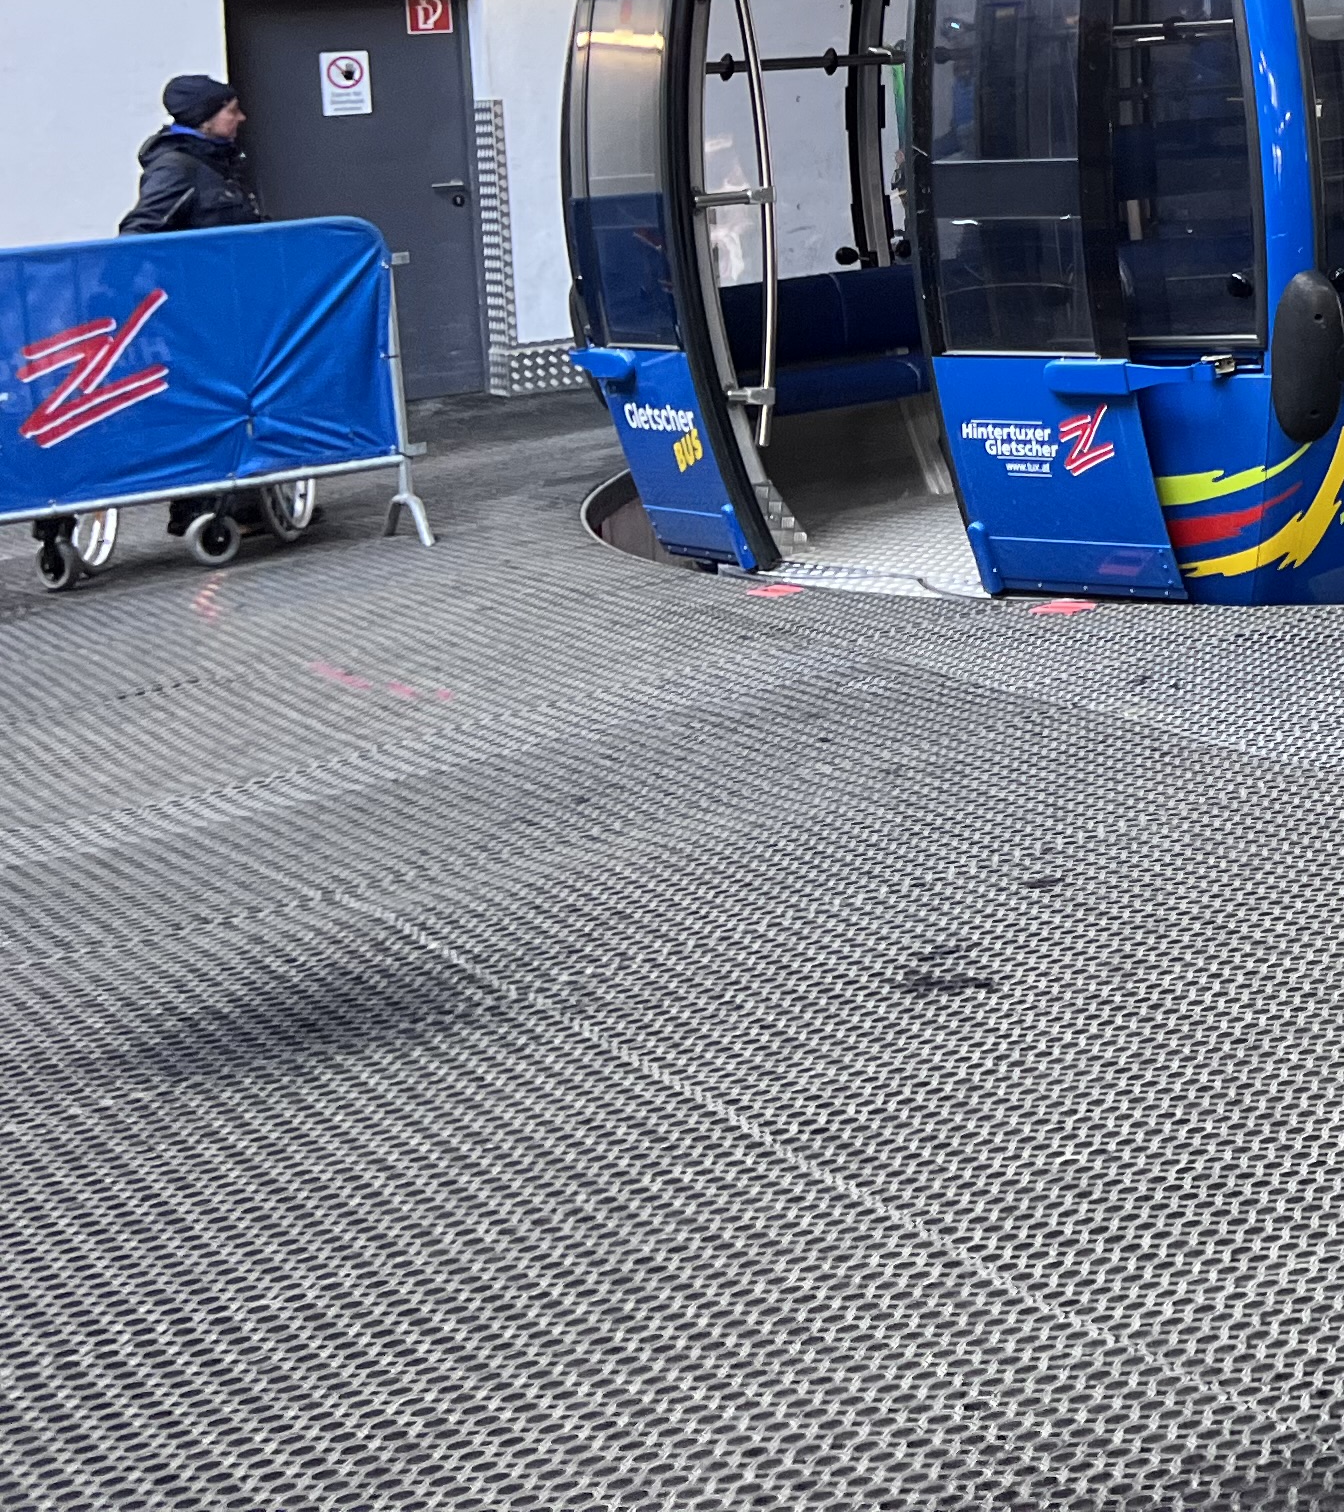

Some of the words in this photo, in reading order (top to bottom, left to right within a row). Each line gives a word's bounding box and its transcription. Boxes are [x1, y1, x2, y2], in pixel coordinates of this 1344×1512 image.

[624, 402, 694, 432] Gletscher
[961, 423, 1051, 441] Hintertuxer
[673, 428, 703, 473] BUS
[985, 440, 1058, 457] Gletscher
[1005, 462, 1050, 473] www.tux.at
